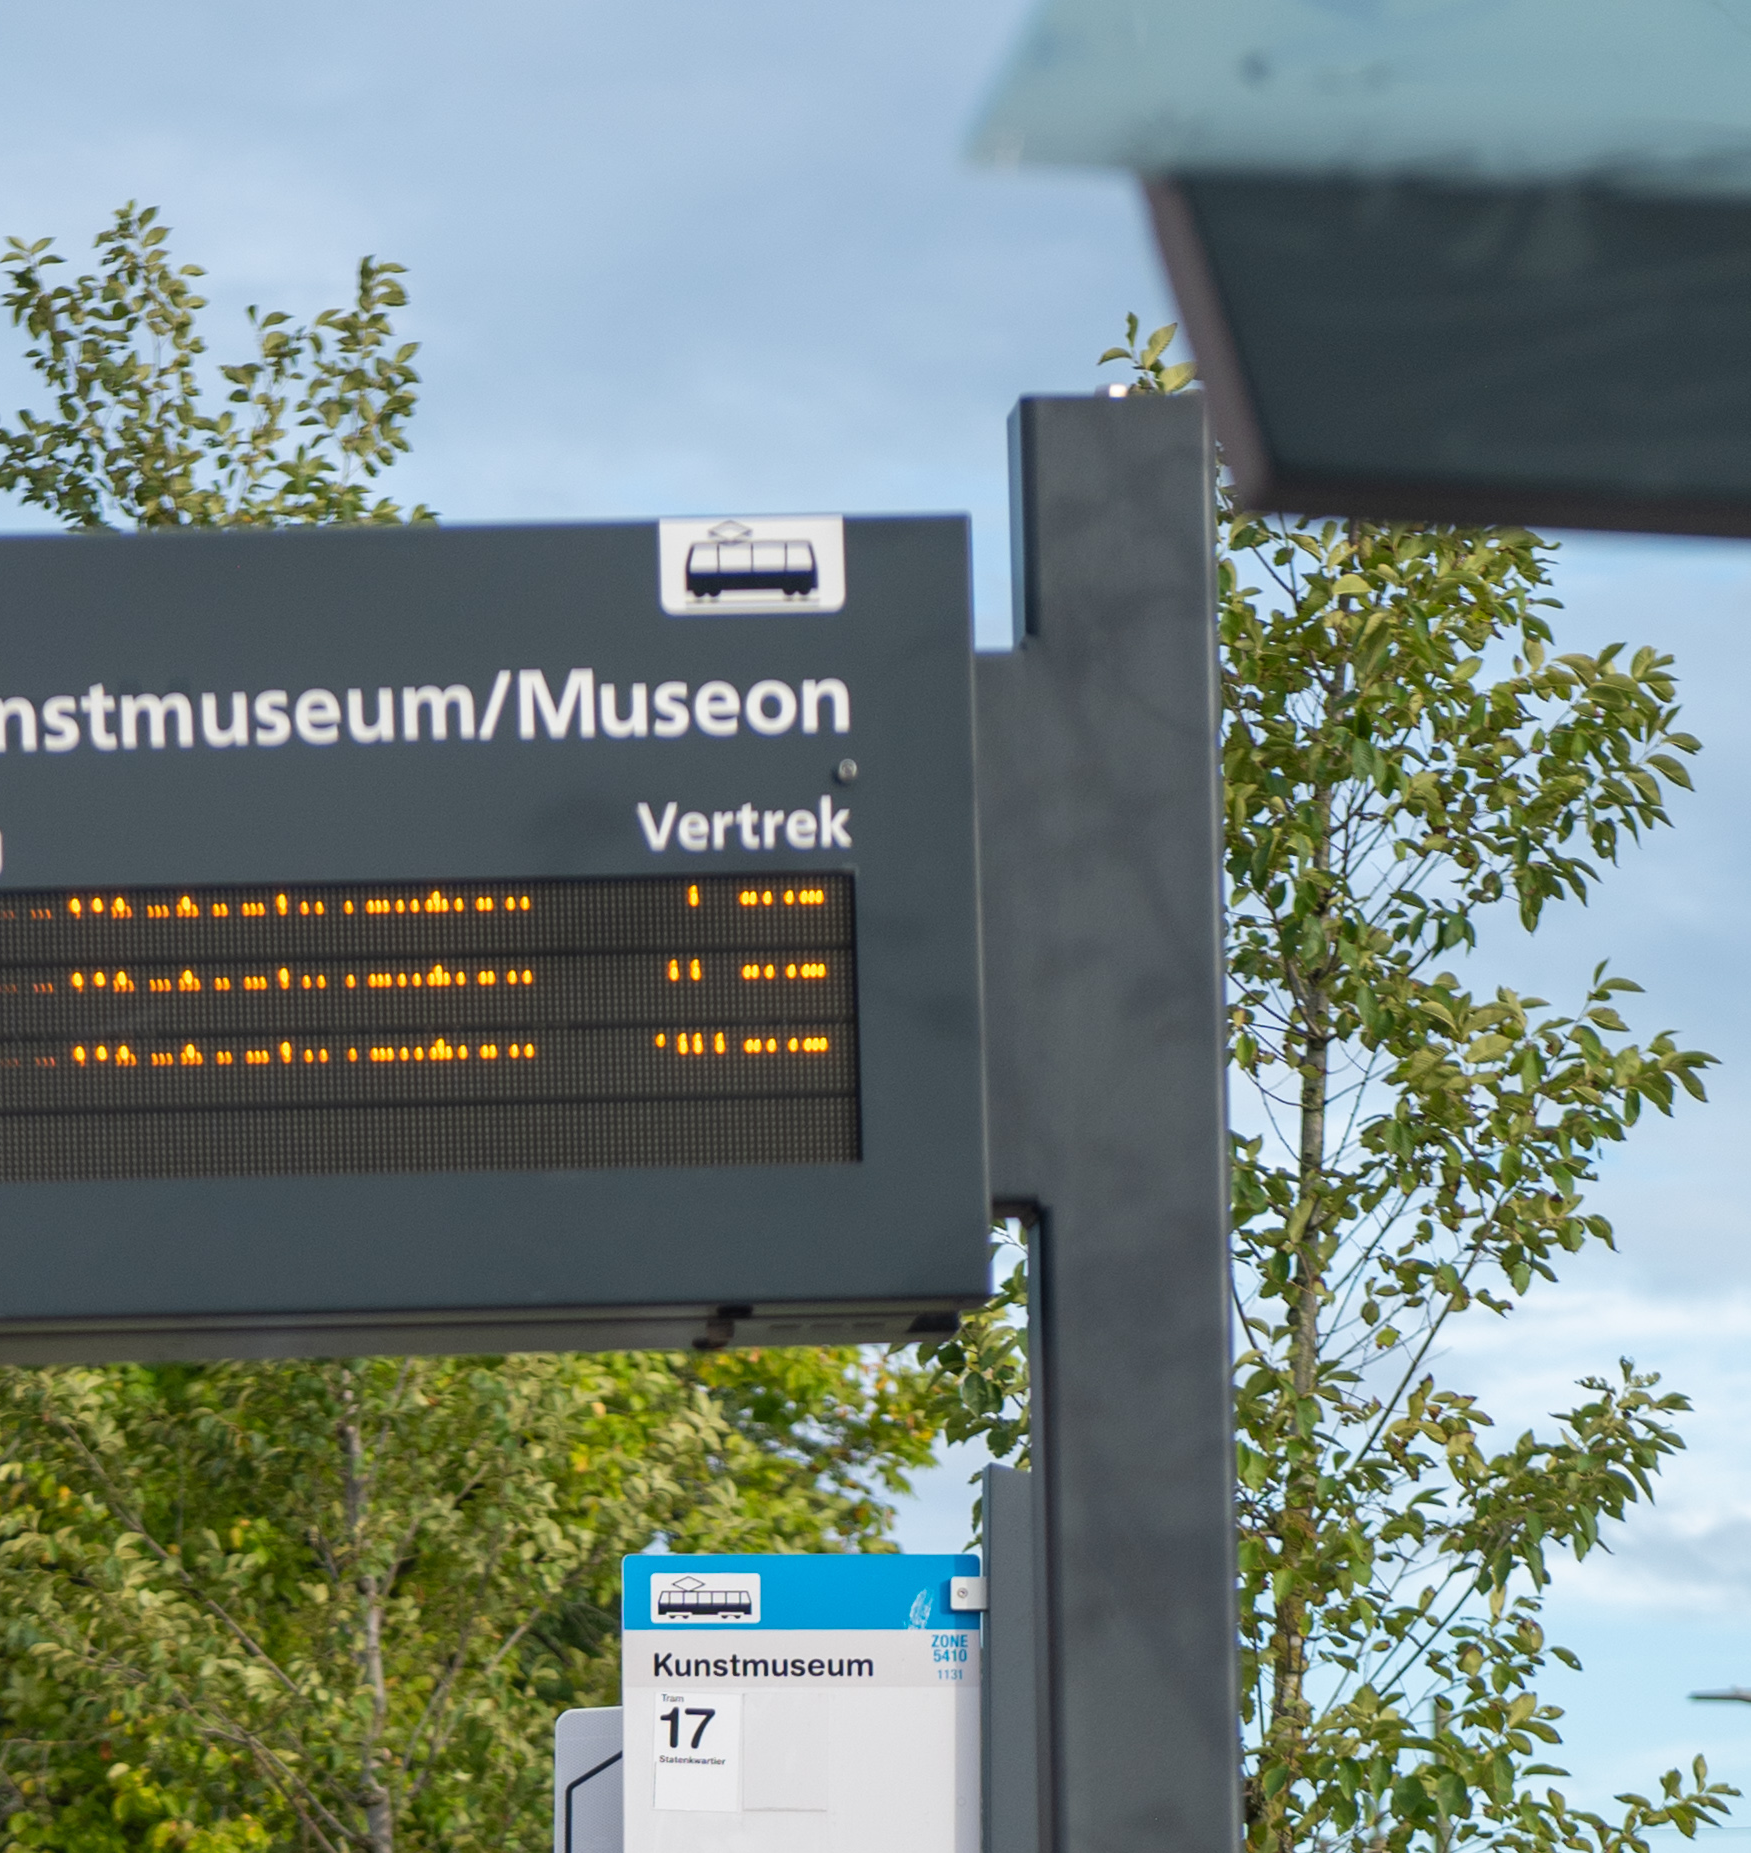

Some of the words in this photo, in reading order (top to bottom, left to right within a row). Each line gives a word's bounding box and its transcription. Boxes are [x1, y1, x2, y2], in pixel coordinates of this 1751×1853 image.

[637, 795, 852, 852] Vertrek
[931, 1634, 969, 1648] ZONE
[933, 1648, 968, 1662] 5410
[653, 1652, 874, 1678] Kunstmuseum
[937, 1668, 963, 1680] 1131
[661, 1693, 685, 1703] Tram
[660, 1706, 716, 1749] 17
[659, 1754, 727, 1765] Statenkwartier
